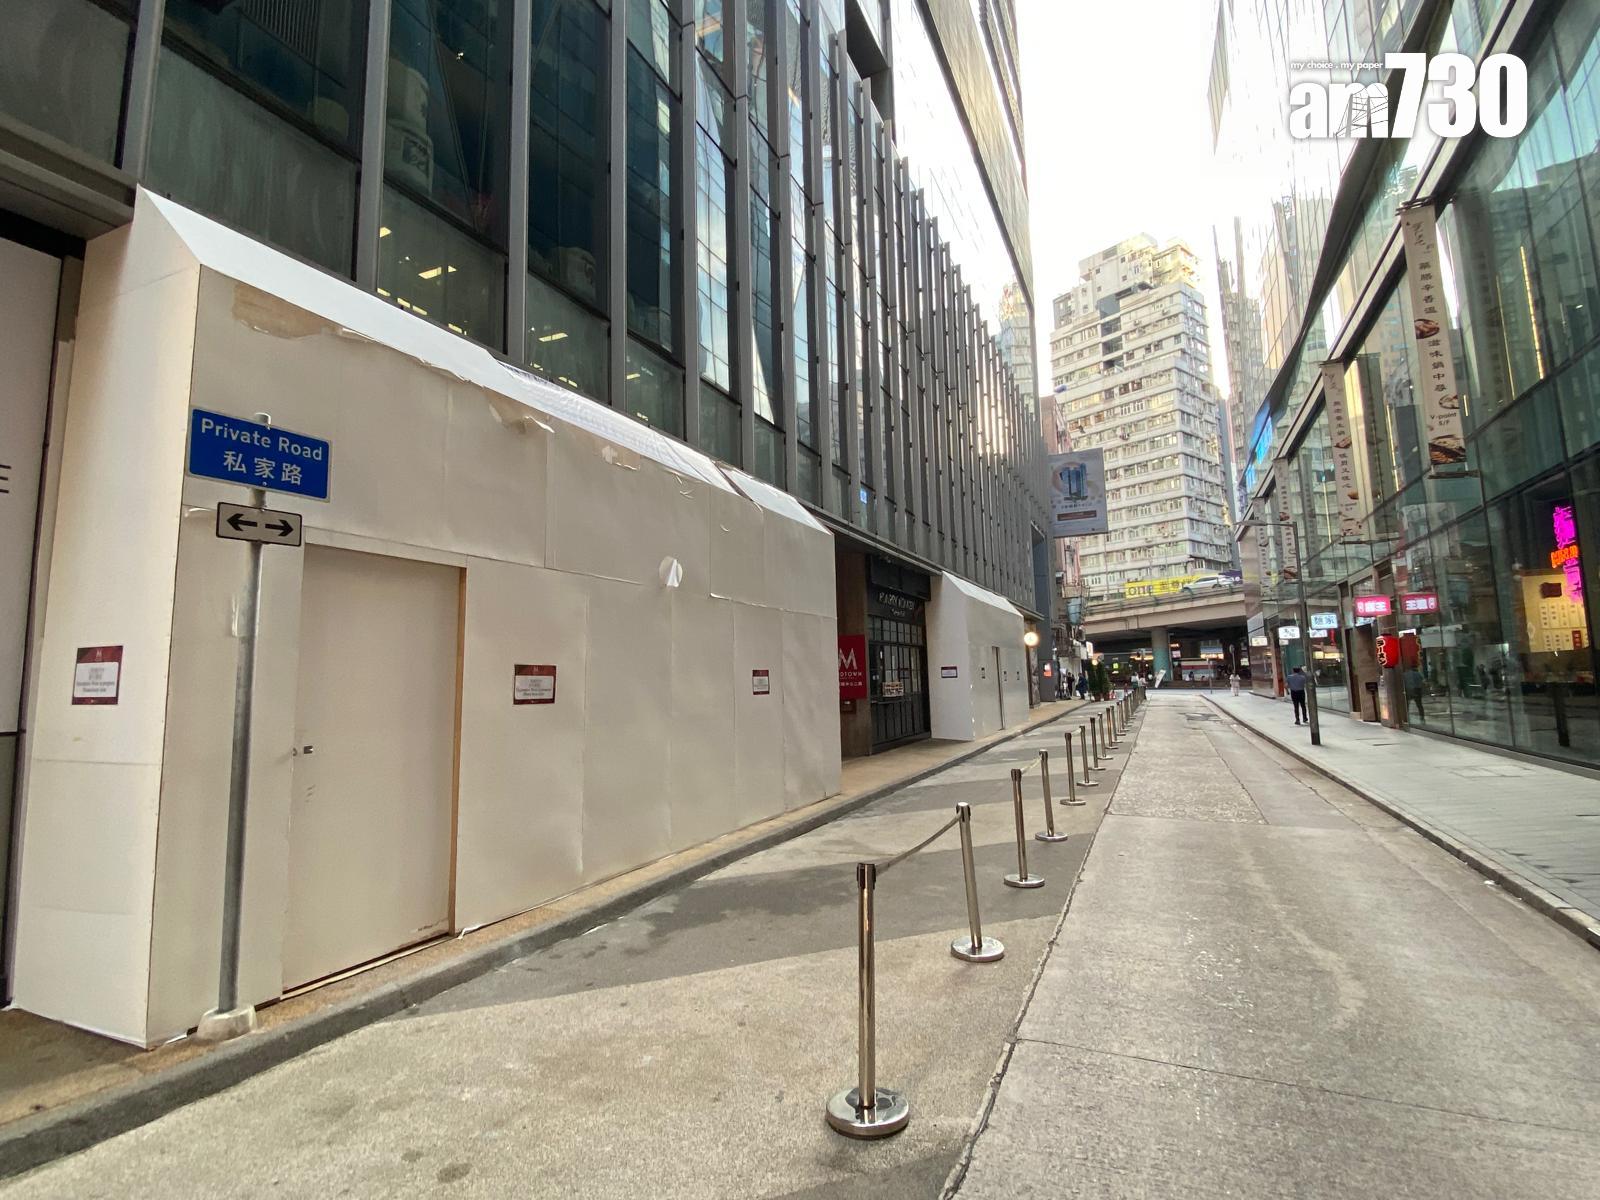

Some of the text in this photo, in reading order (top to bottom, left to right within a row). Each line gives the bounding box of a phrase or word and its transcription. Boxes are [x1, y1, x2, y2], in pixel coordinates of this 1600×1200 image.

[202, 418, 322, 460] Private Road
[224, 451, 302, 484] 私家路
[839, 647, 858, 670] M
